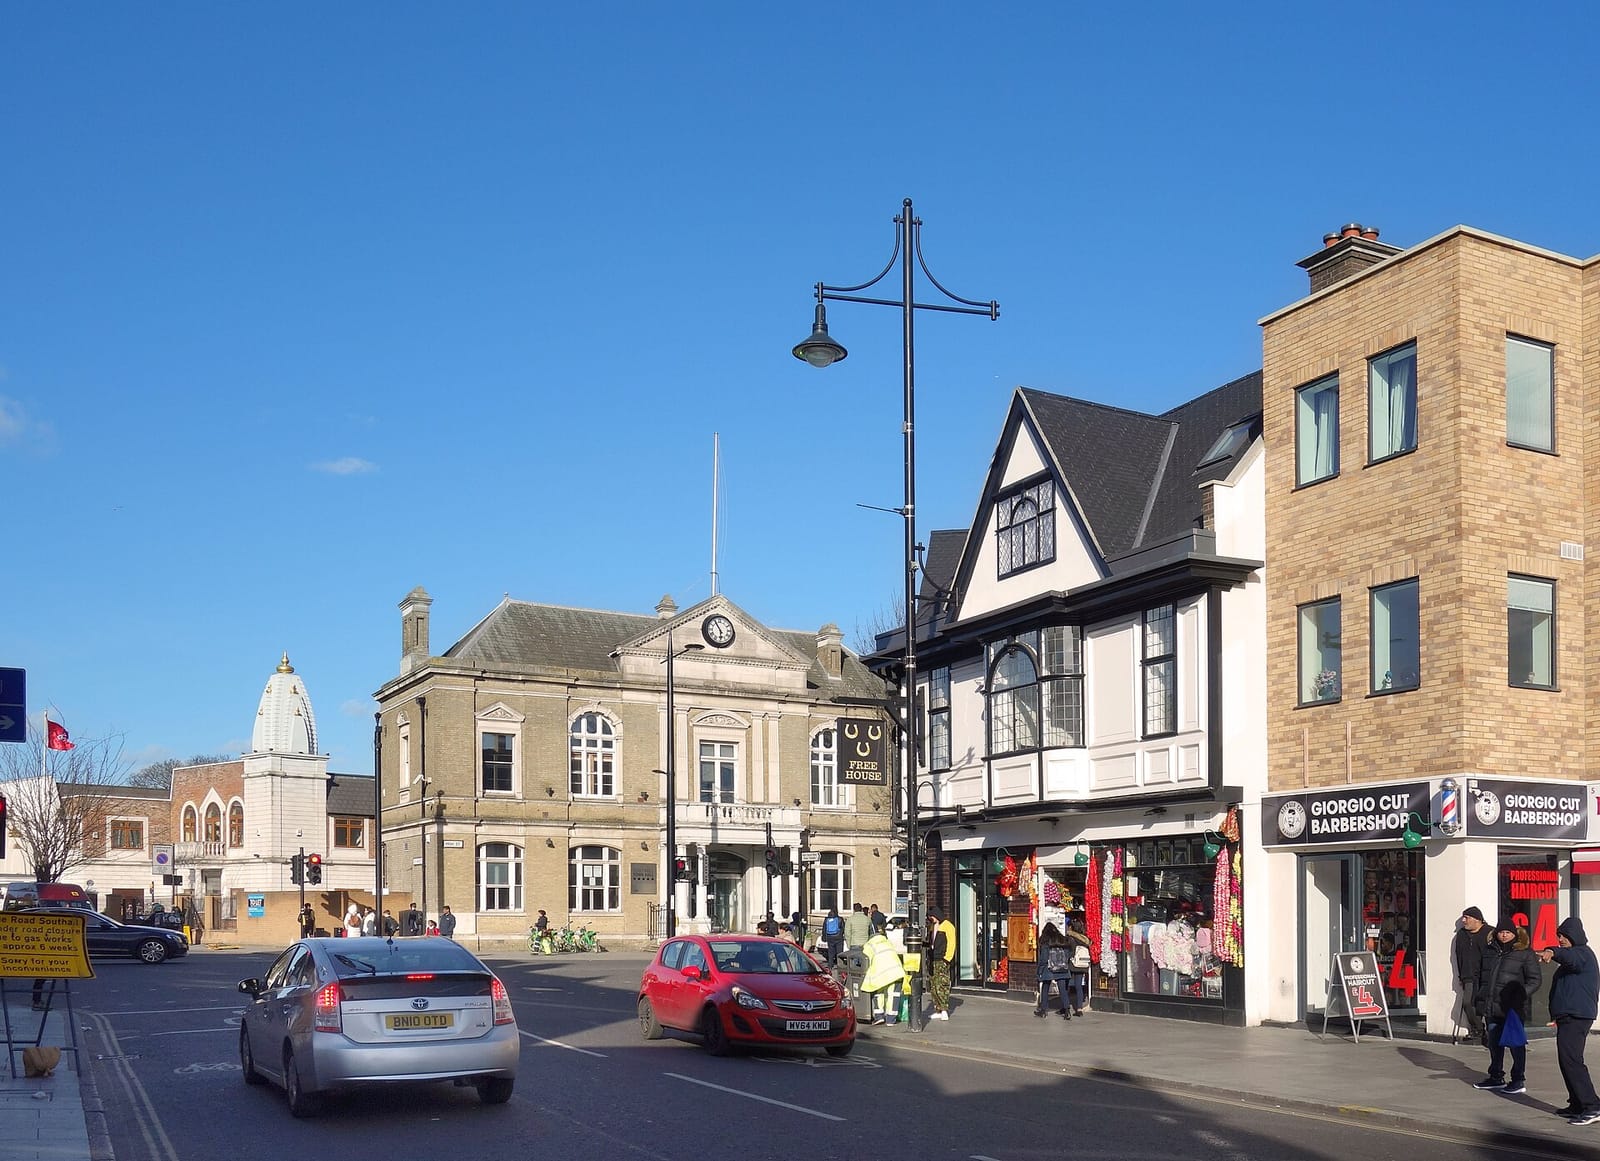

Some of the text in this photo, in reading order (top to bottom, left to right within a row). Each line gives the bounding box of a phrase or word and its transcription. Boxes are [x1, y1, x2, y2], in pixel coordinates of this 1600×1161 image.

[849, 760, 878, 770] FREE
[845, 770, 882, 781] HOUSE
[1311, 793, 1410, 817] GIORGIO CUT
[1504, 794, 1557, 810] GIORGIO
[1559, 797, 1581, 811] CUT
[1504, 809, 1581, 826] BARBERSHOP
[1311, 812, 1409, 835] BARBERSHOP
[1511, 882, 1558, 900] HAIRCUT
[11, 916, 35, 925] Road
[22, 926, 43, 934] road
[46, 927, 81, 935] closure
[11, 932, 21, 941] to
[24, 935, 40, 943] gas
[44, 935, 72, 943] works
[2, 943, 36, 951] approx
[48, 944, 79, 952] weeks
[1, 957, 69, 966] Sorry for your
[2, 965, 72, 973] inconvenience
[1347, 979, 1375, 987] HAIRCUT
[393, 1016, 421, 1027] BN10
